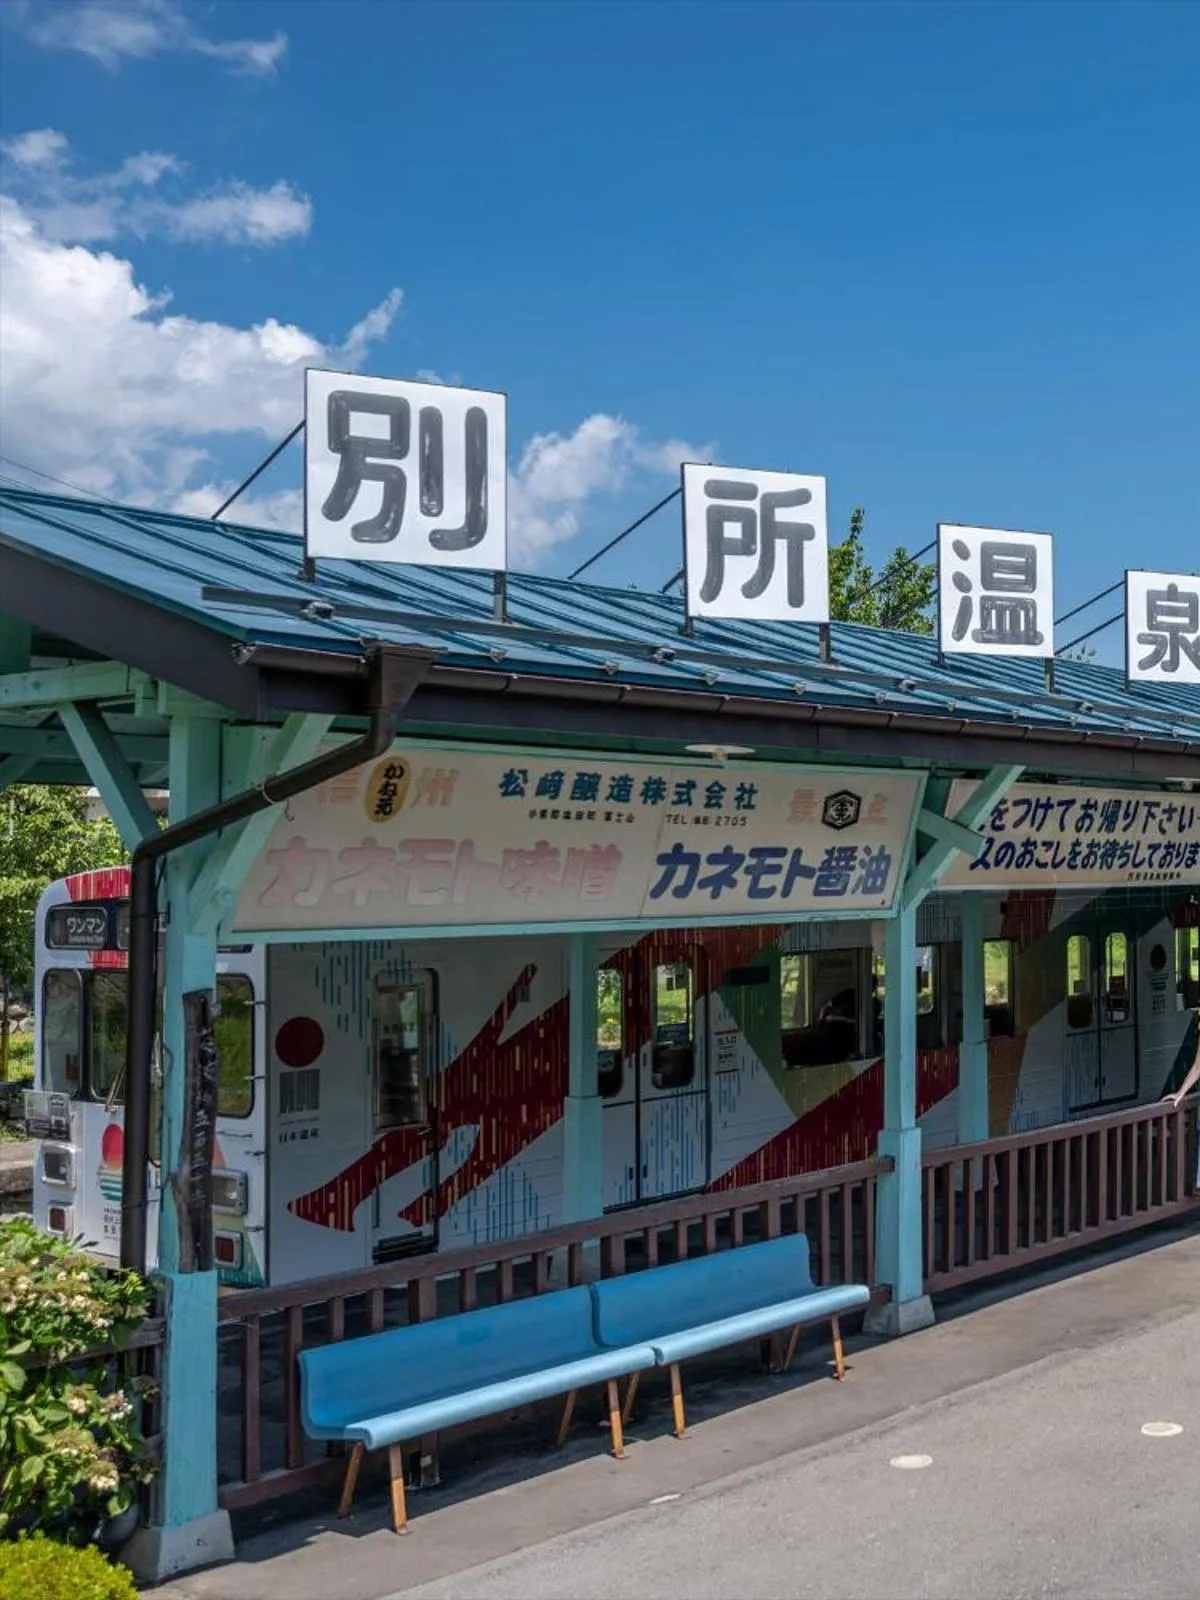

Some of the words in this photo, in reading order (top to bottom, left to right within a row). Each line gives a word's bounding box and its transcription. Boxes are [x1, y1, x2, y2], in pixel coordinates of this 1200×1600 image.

[320, 389, 489, 552] 別
[699, 479, 816, 609] 所
[951, 538, 1045, 646] 温
[665, 813, 688, 826] TEL
[649, 842, 893, 899] カネモト醤油
[66, 916, 106, 934] ワンマン
